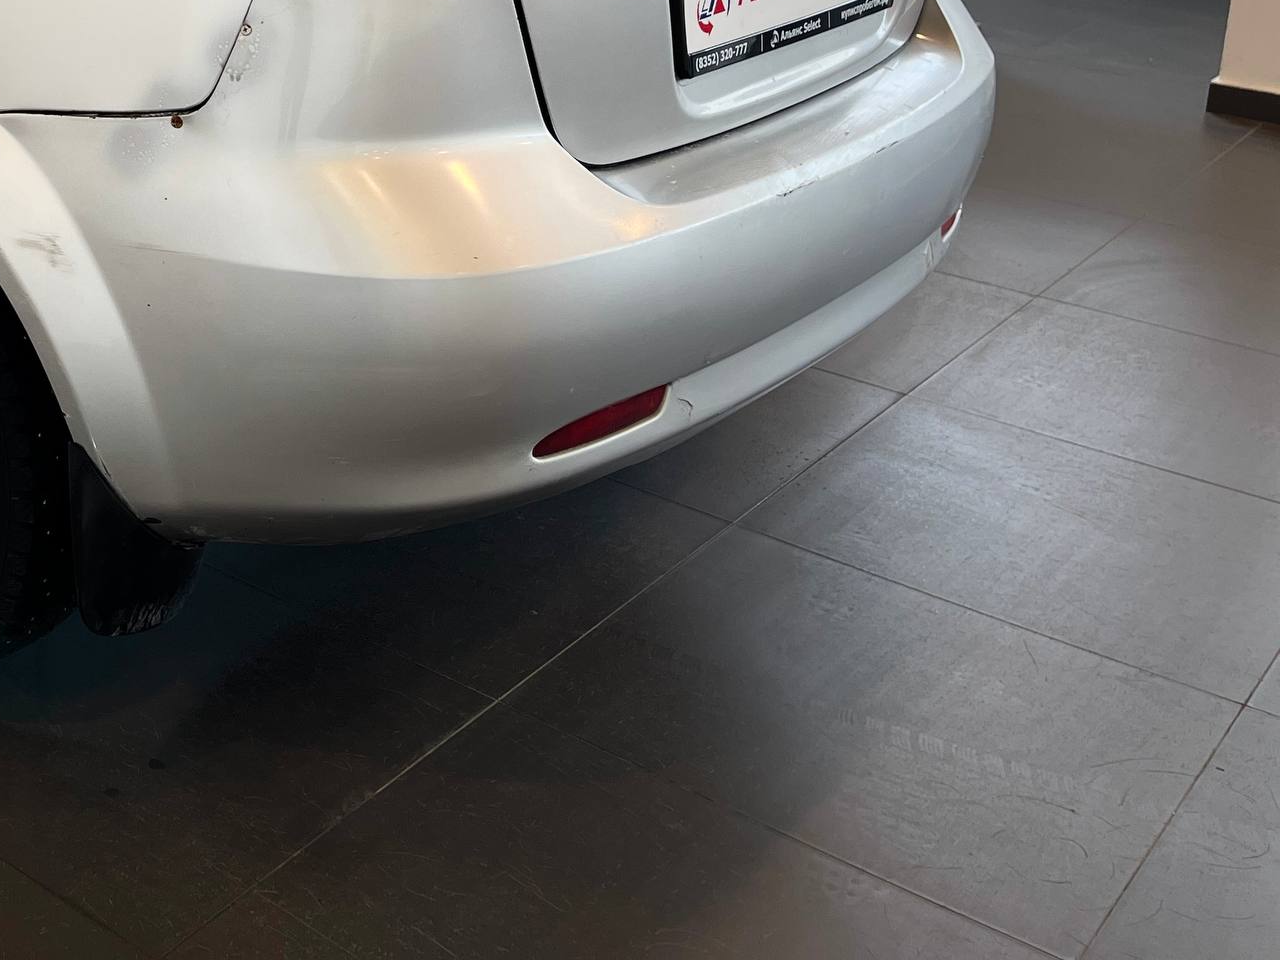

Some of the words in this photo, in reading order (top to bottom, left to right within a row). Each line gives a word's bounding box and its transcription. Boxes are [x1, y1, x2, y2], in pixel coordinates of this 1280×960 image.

[780, 23, 803, 41] Альянс
[803, 18, 821, 33] Select
[695, 52, 719, 72] (8352)
[720, 42, 748, 61] 320-777
